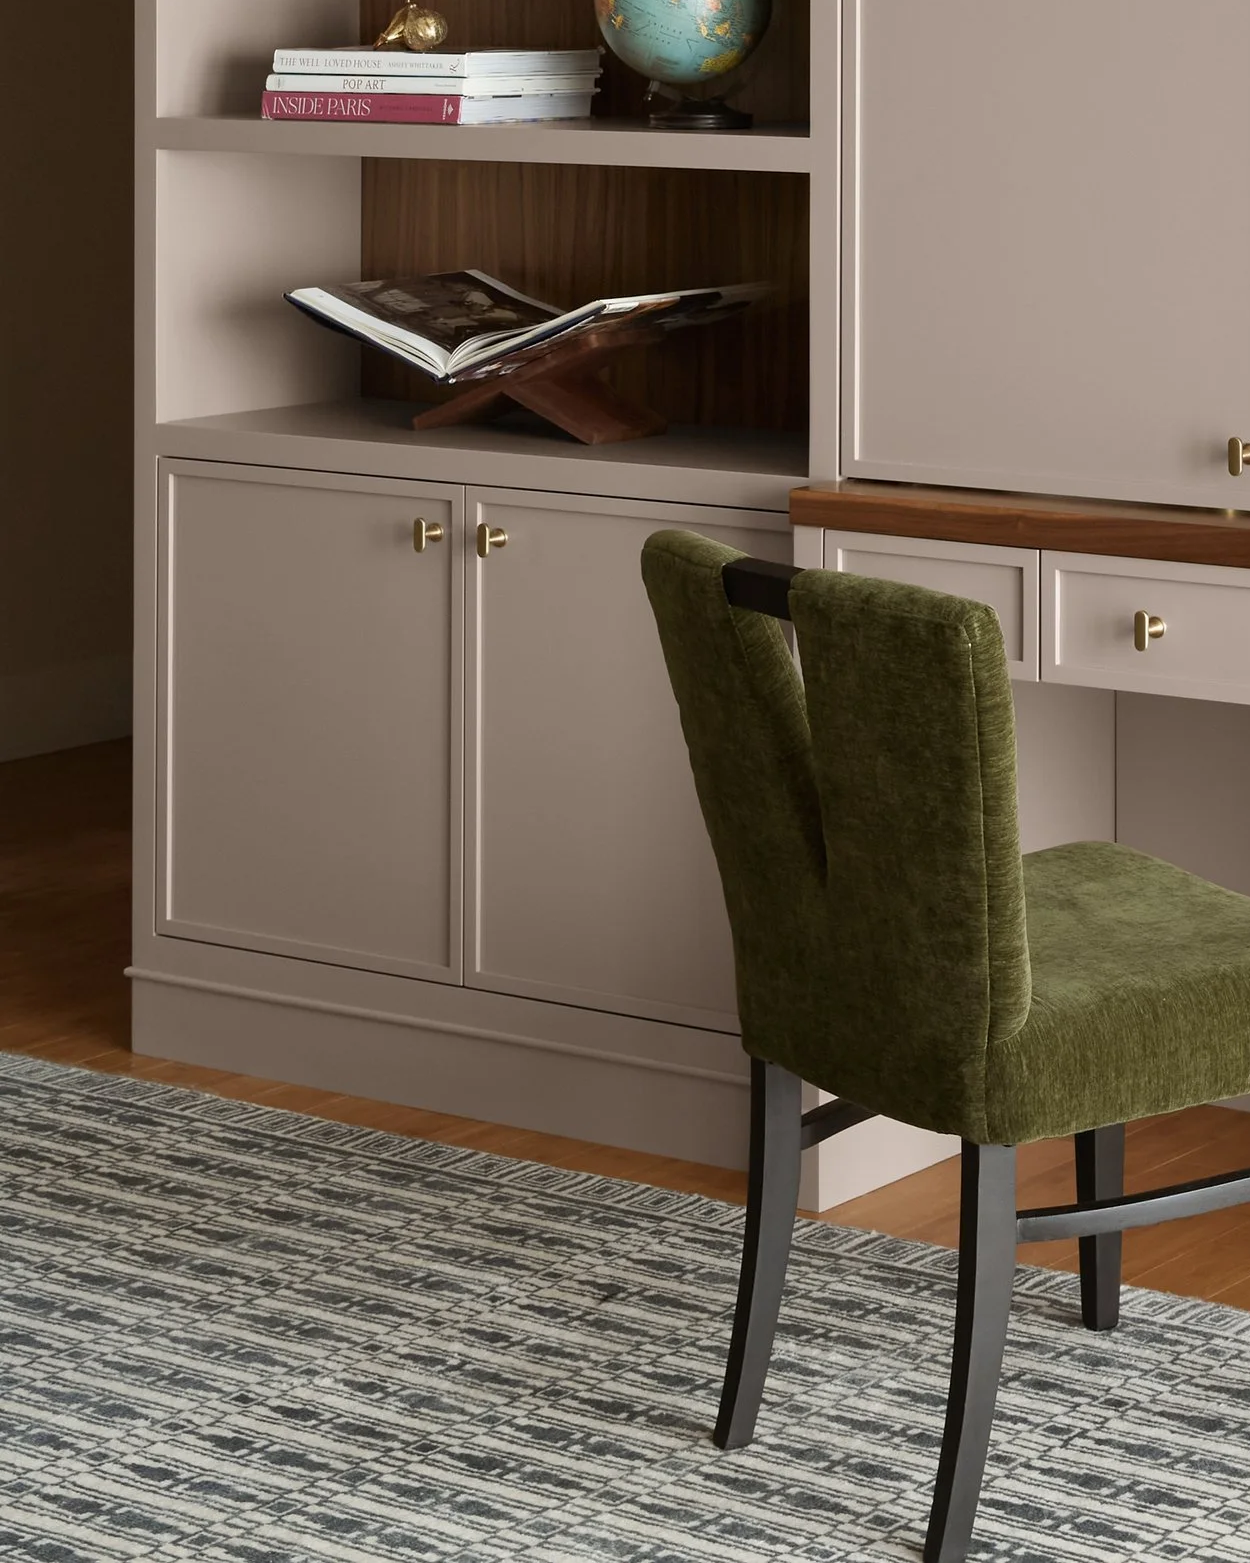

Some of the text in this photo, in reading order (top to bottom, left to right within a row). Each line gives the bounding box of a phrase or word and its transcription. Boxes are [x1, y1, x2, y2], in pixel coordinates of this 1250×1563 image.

[280, 57, 382, 69] THE WELL LOVED HOUSE
[342, 78, 387, 90] POP ART
[273, 96, 372, 116] INSIDE PARIS
